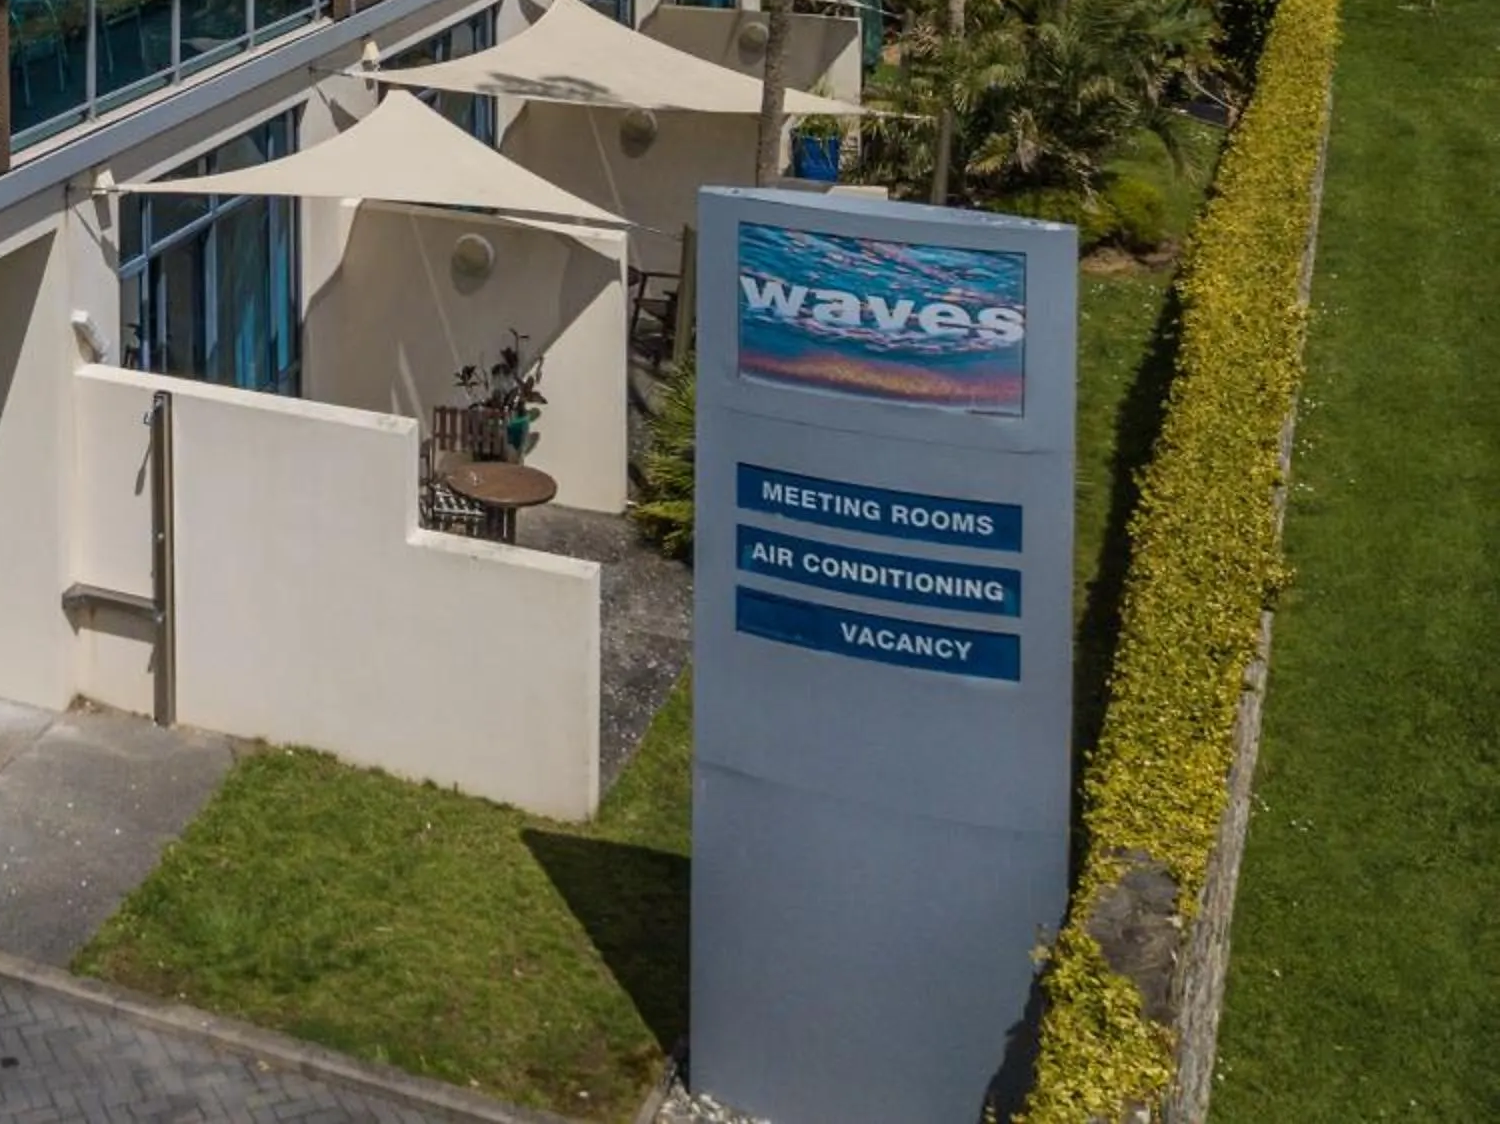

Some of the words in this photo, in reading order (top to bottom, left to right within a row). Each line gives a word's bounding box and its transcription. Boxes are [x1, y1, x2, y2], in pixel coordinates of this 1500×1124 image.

[740, 275, 1025, 343] waves
[762, 482, 881, 521] MEETING
[891, 504, 995, 535] ROOMS
[751, 543, 794, 568] AIR
[803, 555, 1004, 602] CONDITIONING
[841, 622, 973, 661] VACANCY
